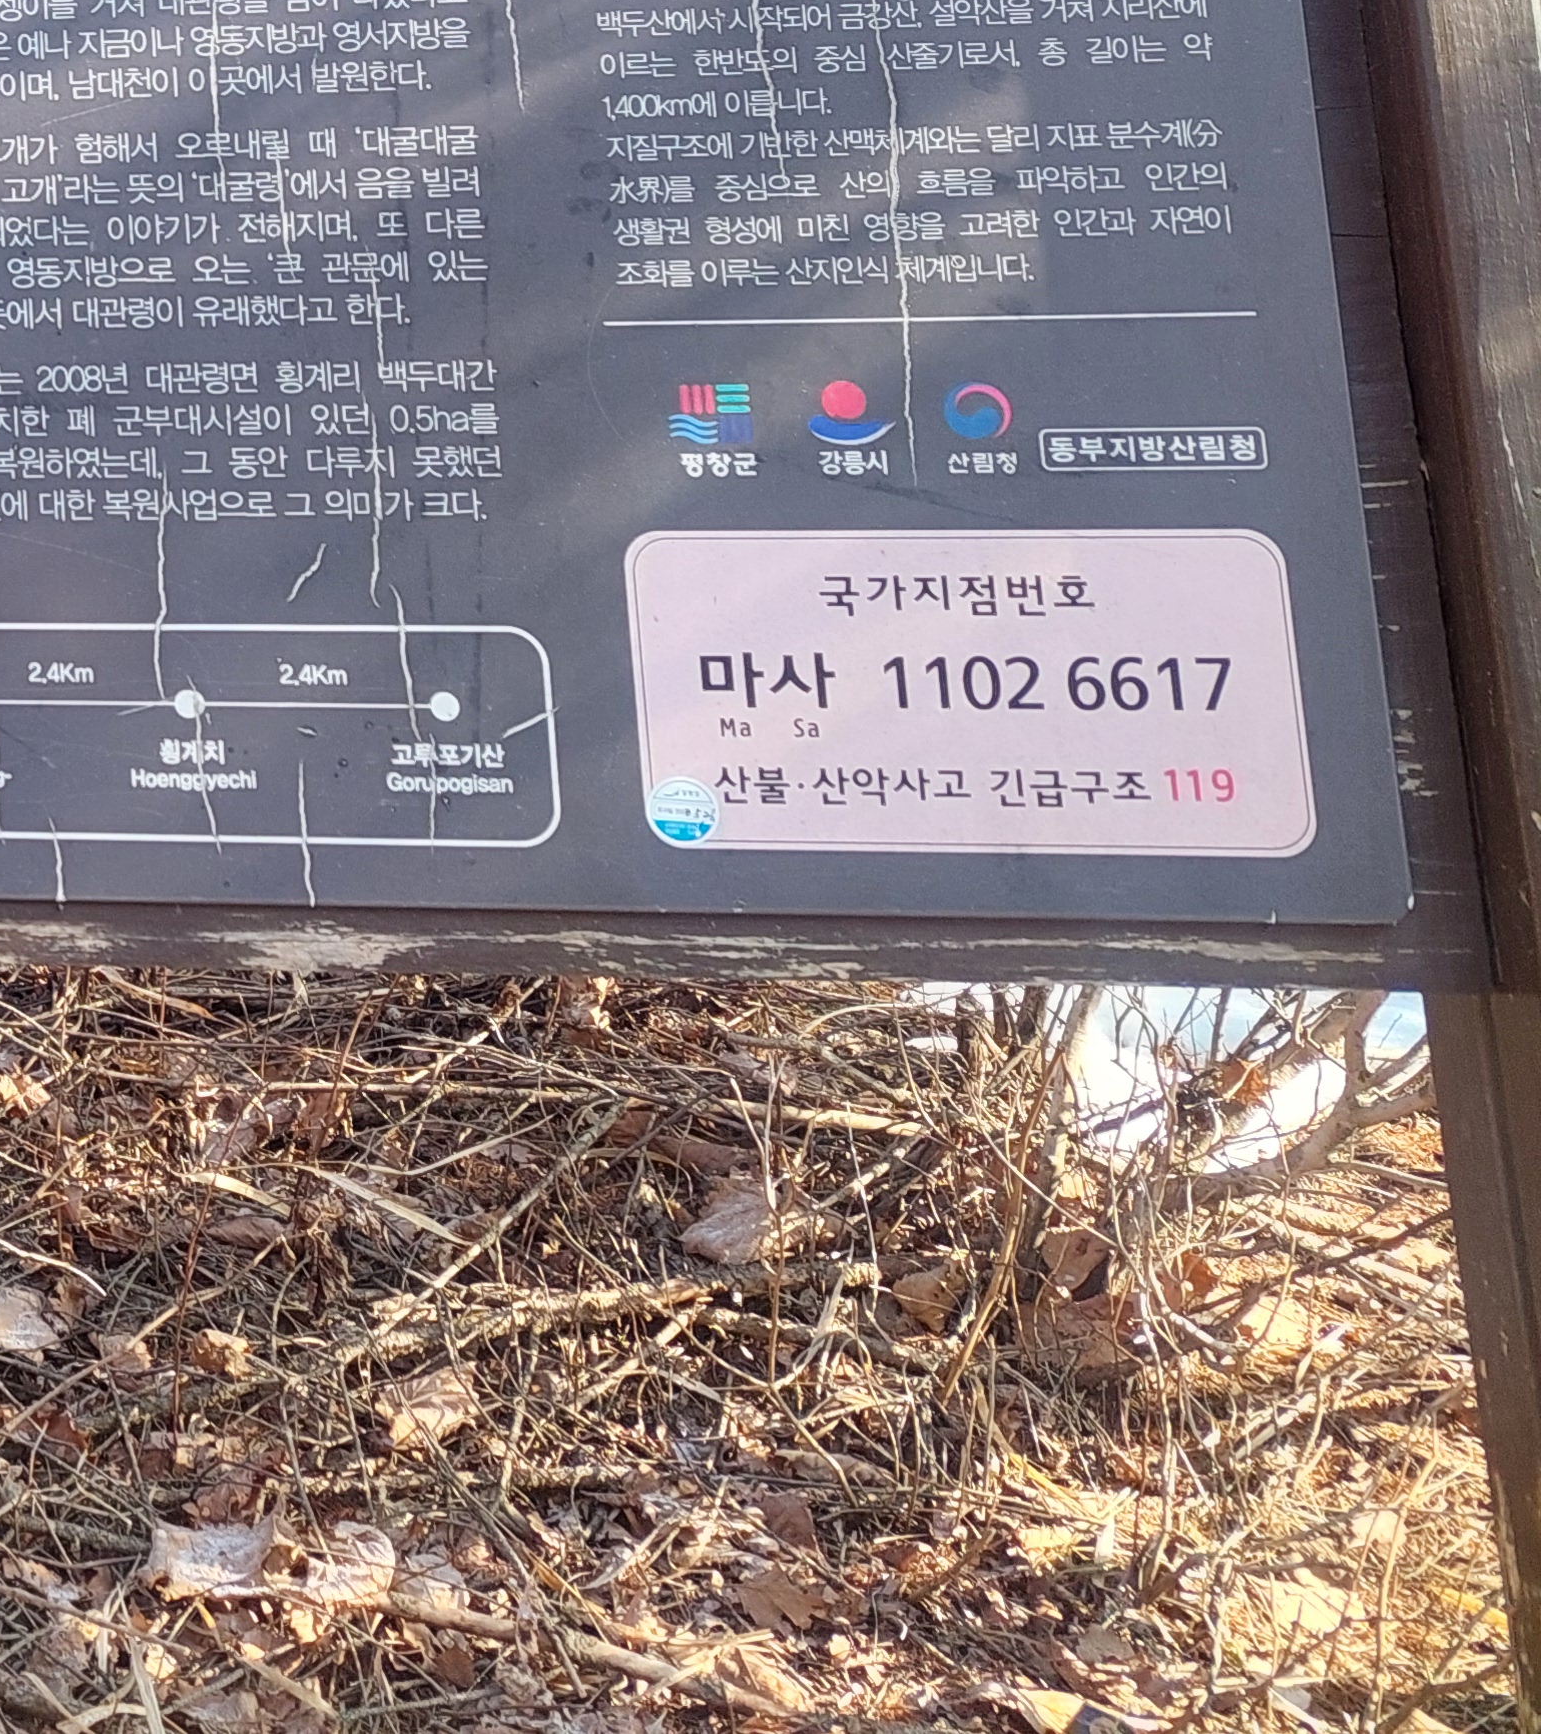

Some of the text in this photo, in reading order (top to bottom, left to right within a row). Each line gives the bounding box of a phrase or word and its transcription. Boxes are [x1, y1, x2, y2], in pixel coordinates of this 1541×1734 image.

[18, 29, 72, 60] 예나
[78, 25, 184, 59] 지금이나
[191, 22, 327, 57] 영동지방과
[333, 17, 471, 51] 영서지방을
[724, 88, 832, 117] 이릅니다.
[74, 132, 158, 164] 험해서
[175, 128, 290, 160] 오르내릴
[309, 127, 337, 159] 때
[715, 173, 820, 202] 중심으로
[840, 170, 890, 199] 산의
[917, 166, 995, 197] 흐름을
[1016, 164, 1125, 195] 파악하고
[1145, 161, 1227, 192] 인간의
[616, 252, 1034, 288] 조화를 이루는 산지인식 체계입니다.
[72, 295, 184, 330] 대관령이
[192, 294, 338, 327] 유래했다고
[345, 293, 411, 327] 한다.
[67, 405, 95, 436] 폐
[113, 404, 292, 437] 군부대시설이
[310, 404, 370, 435] 있던
[390, 403, 500, 434] 0.5ha를
[818, 449, 889, 475] 강릉시
[948, 450, 1017, 475] 산림청
[1048, 434, 1257, 463] 동부지방산림청
[680, 452, 758, 477] 평창군
[818, 574, 1095, 617] 국가지점번호
[28, 662, 94, 685] 2.4Km
[279, 664, 348, 686] 2.4Km
[883, 655, 1045, 711] 1102
[1068, 656, 1231, 711] 6617
[720, 718, 820, 739] Ma Sa
[160, 739, 225, 765] 횡계치
[391, 744, 505, 768] 고루포기산
[131, 769, 257, 792] Hoenggyechi
[386, 772, 513, 795] Gorupogisan
[714, 766, 1235, 807] 산불·산악사고 긴급구조 119
